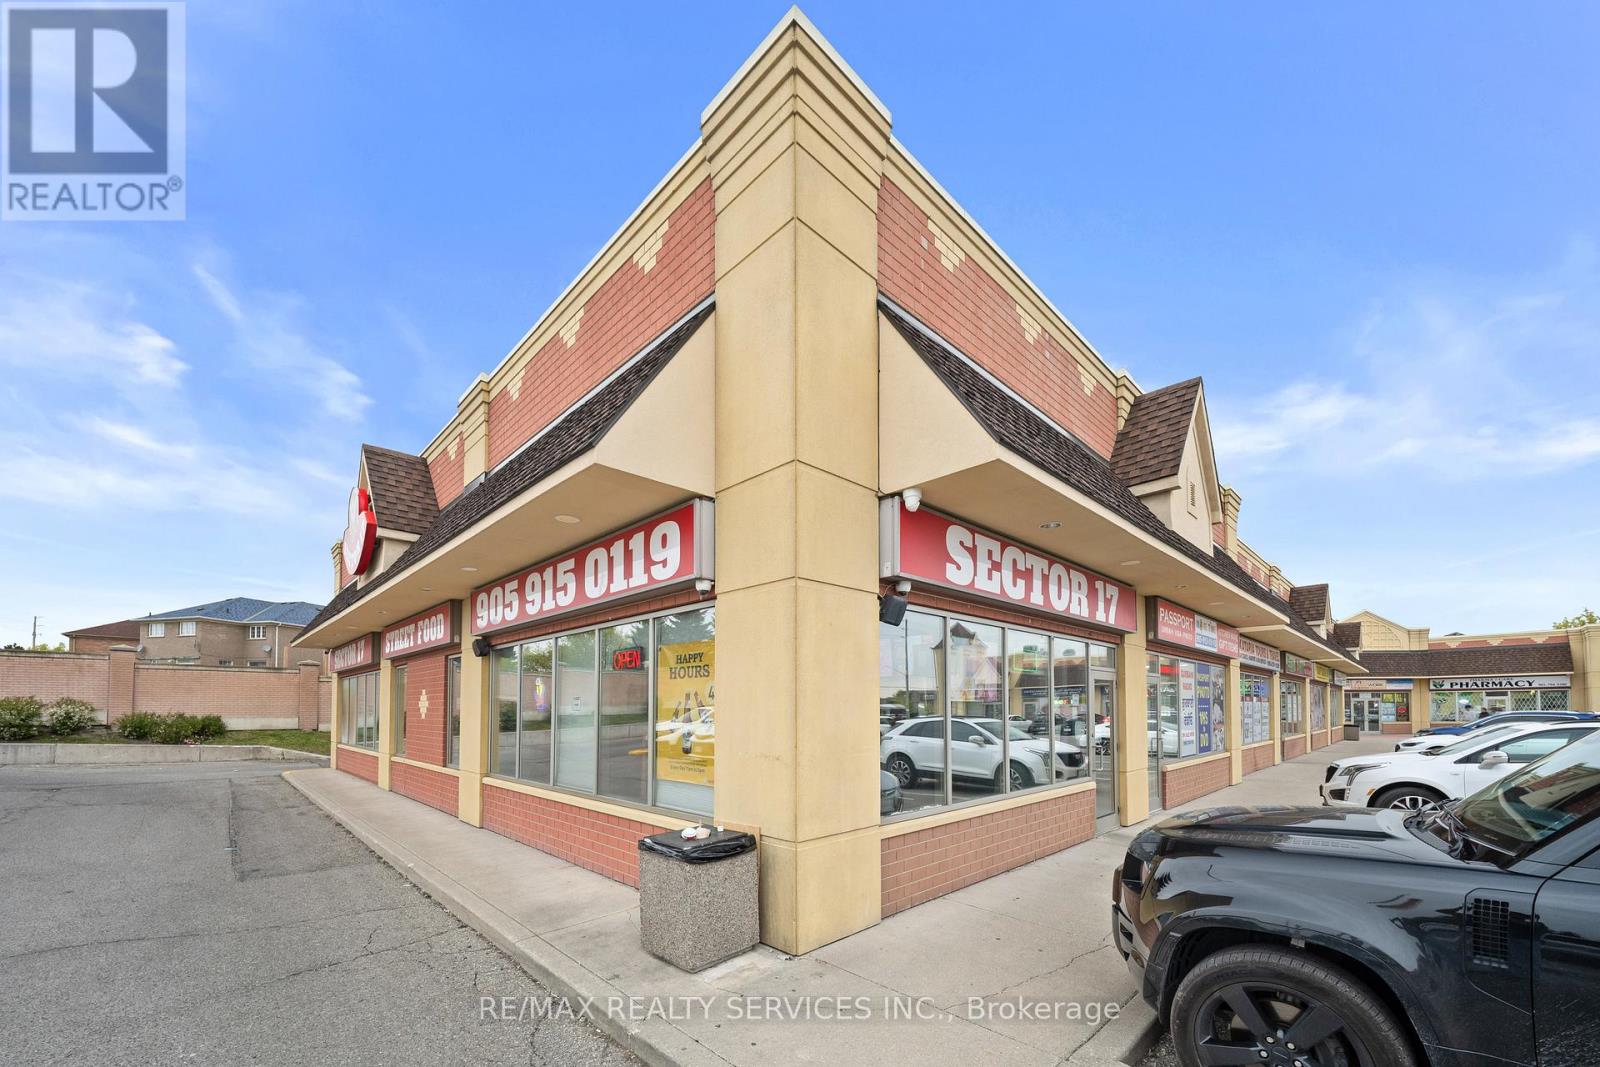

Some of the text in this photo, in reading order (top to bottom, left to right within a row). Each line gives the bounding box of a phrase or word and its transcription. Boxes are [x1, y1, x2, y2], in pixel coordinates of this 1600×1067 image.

[476, 520, 681, 629] 905 915 0119
[945, 524, 1119, 625] SECTOR 17
[1159, 607, 1194, 631] PASSPORT
[385, 613, 445, 654] STREET FOOD
[613, 650, 641, 671] OPEN
[676, 652, 704, 665] HAPPY
[669, 664, 710, 680] HOURS
[1450, 679, 1536, 689] PHARMACY
